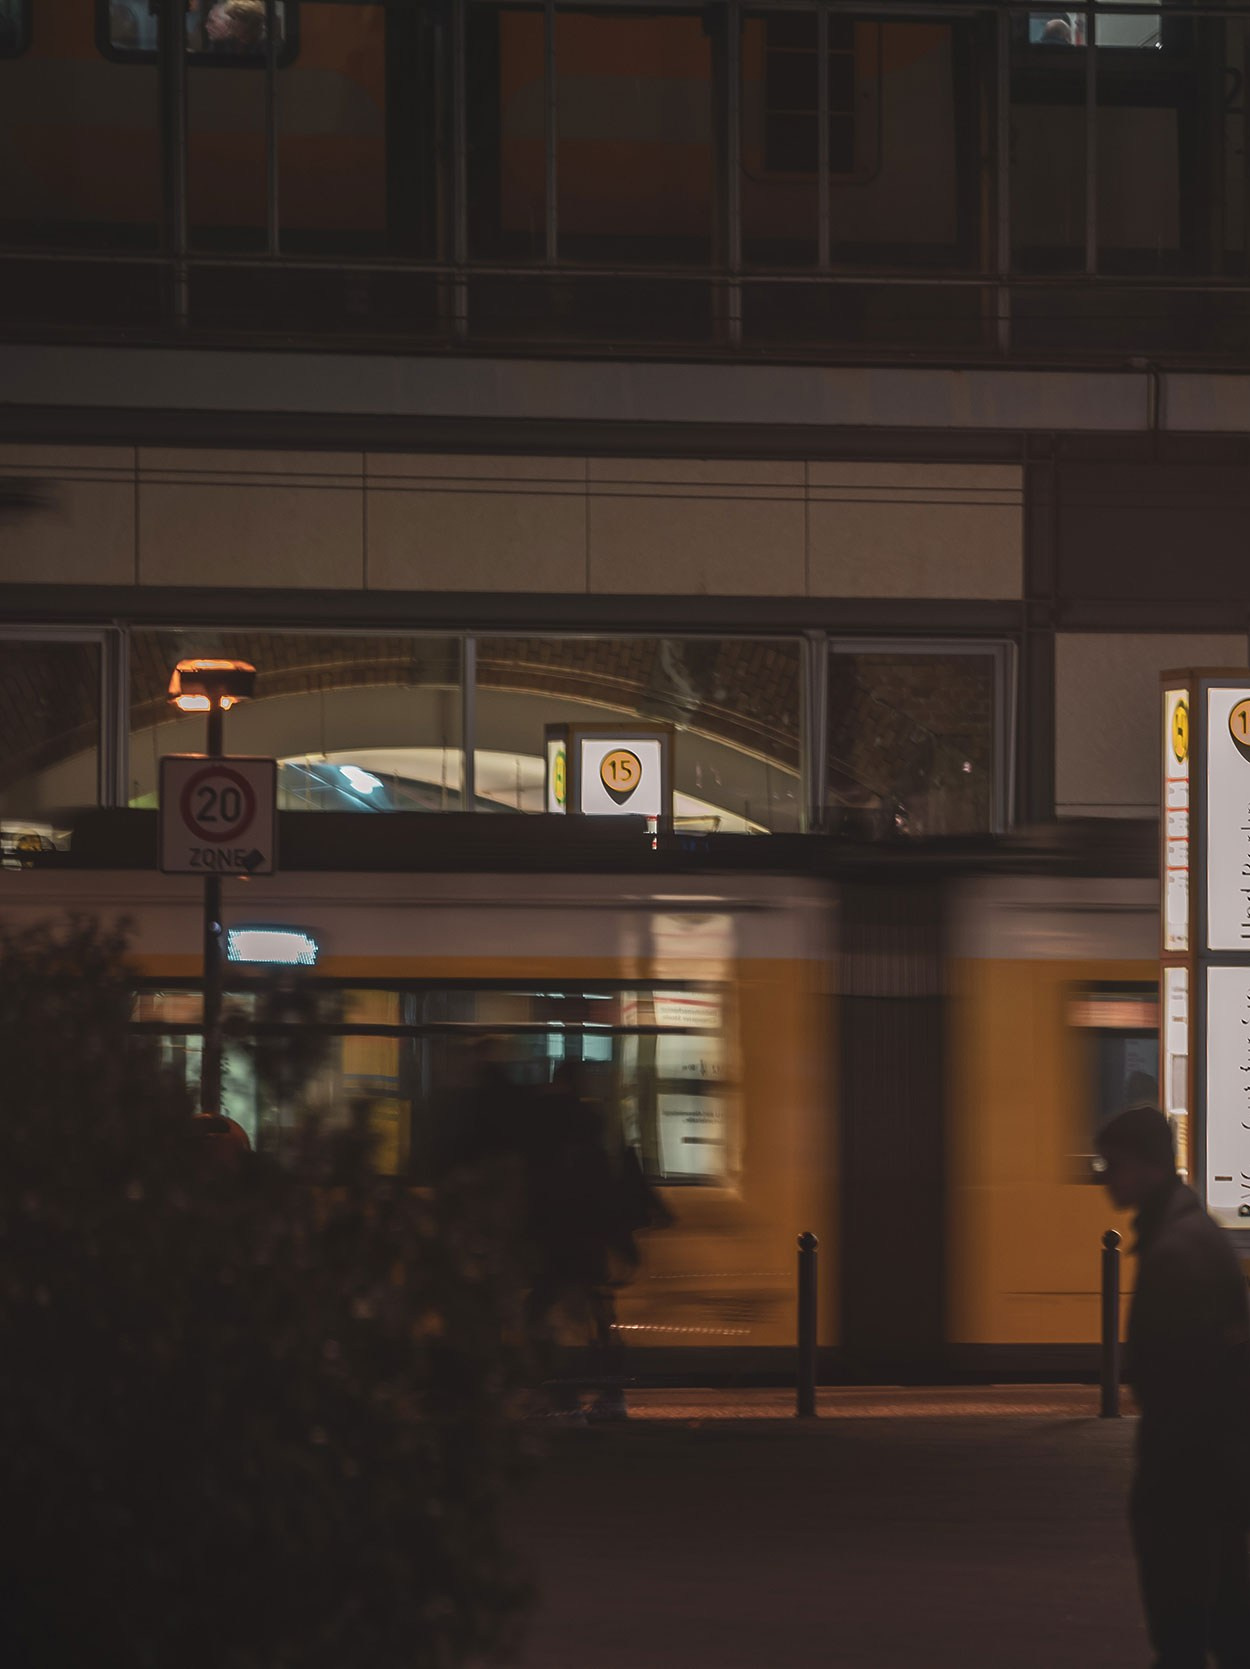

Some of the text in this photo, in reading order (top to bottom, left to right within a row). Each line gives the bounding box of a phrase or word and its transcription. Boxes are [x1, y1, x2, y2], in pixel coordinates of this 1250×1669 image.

[609, 759, 632, 781] 15
[197, 786, 240, 822] 20
[189, 848, 246, 869] ZONE
